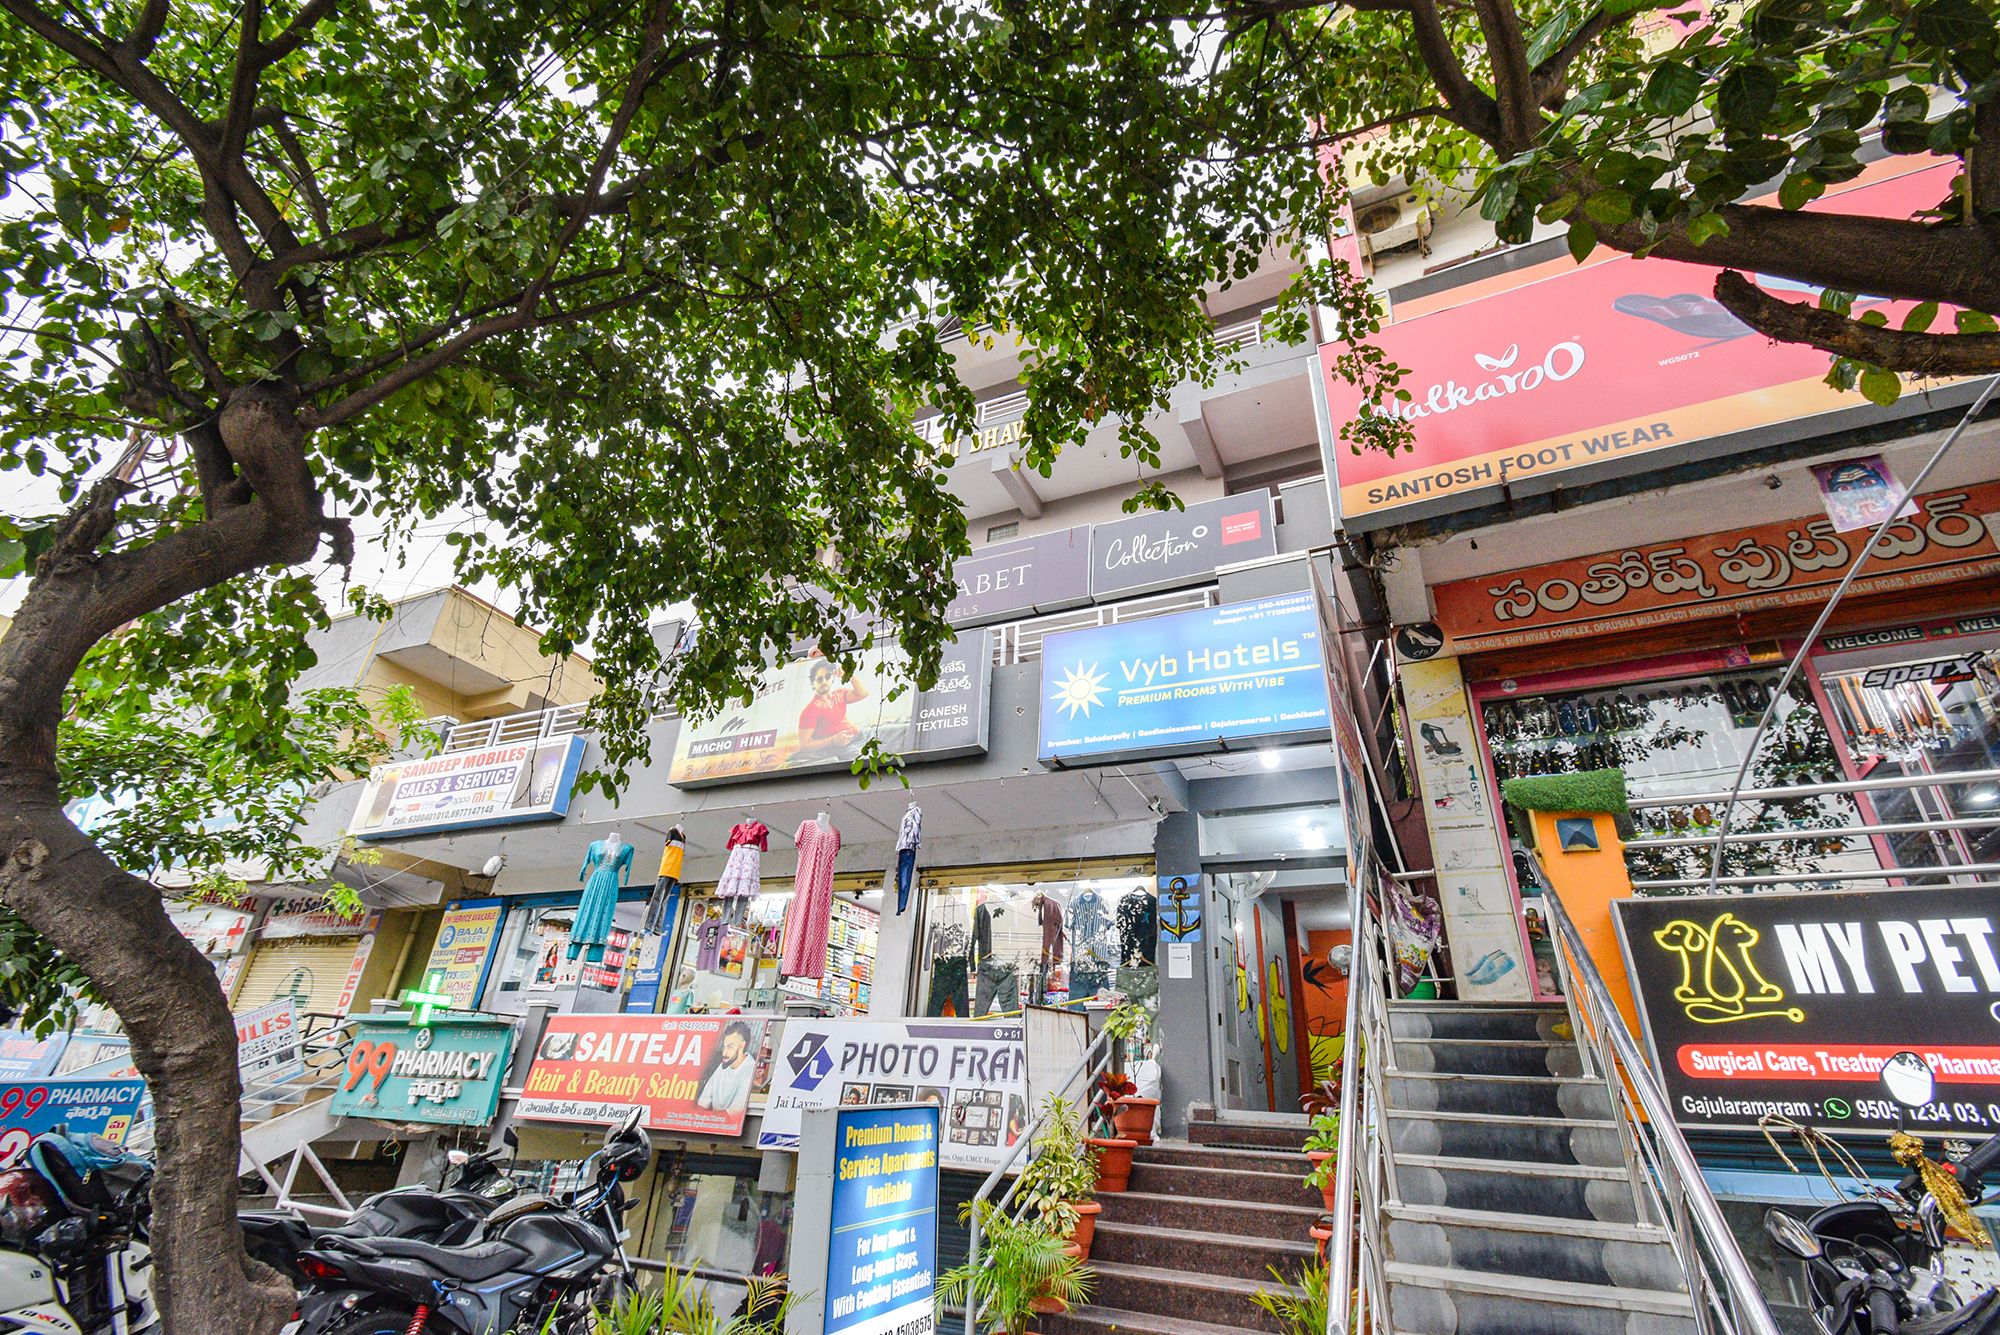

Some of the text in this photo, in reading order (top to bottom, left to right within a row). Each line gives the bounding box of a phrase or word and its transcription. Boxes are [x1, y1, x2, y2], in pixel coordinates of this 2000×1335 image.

[1367, 421, 1675, 505] SANTOSH FOOT WEAR
[1105, 529, 1198, 571] Collection
[1550, 624, 1592, 640] COMPLEX,
[1636, 609, 1688, 627] MULLAPUDI
[1689, 603, 1733, 619] HOSPITAL
[1756, 593, 1785, 610] GATE,
[1785, 579, 1874, 605] GAJULARAARAM
[1875, 574, 1908, 591] ROAD,
[1826, 626, 1922, 650] WELCOME
[1119, 653, 1178, 687] Vyb
[1187, 637, 1301, 674] Hotels
[1863, 651, 1985, 690] sparx
[915, 716, 969, 733] TEXTILES
[919, 703, 968, 720] GANESH
[691, 733, 773, 756] MACHO HINT
[401, 746, 528, 779] SANDEEP MOBILES
[398, 767, 518, 800] SALES & SERVICE
[456, 925, 490, 937] BAJAJ
[1774, 917, 2000, 995] MY PET
[446, 980, 472, 993] HOME
[451, 992, 472, 1004] EDIT
[343, 1040, 498, 1092] 99 PHARMACY
[574, 1032, 702, 1067] SAITEJA
[839, 1042, 939, 1078] PHOTO
[1690, 1050, 1764, 1076] Surgical
[1764, 1050, 1817, 1077] Care,
[527, 1067, 700, 1103] Hair & Beauty Salon
[0, 1085, 142, 1120] 99 PHARMACY
[773, 1095, 789, 1110] Jai
[1681, 1095, 1812, 1119] Gajularamaram
[1854, 1099, 1900, 1121] 9505
[1952, 1102, 1989, 1127] 03,
[845, 1122, 933, 1149] Premium Rooms &
[839, 1149, 936, 1182] Service Apartments
[864, 1179, 913, 1209] Available
[856, 1237, 872, 1257] For
[909, 1226, 917, 1243] &
[851, 1250, 919, 1286] Long-term Stays,
[832, 1268, 931, 1320] With Cooking Essentials
